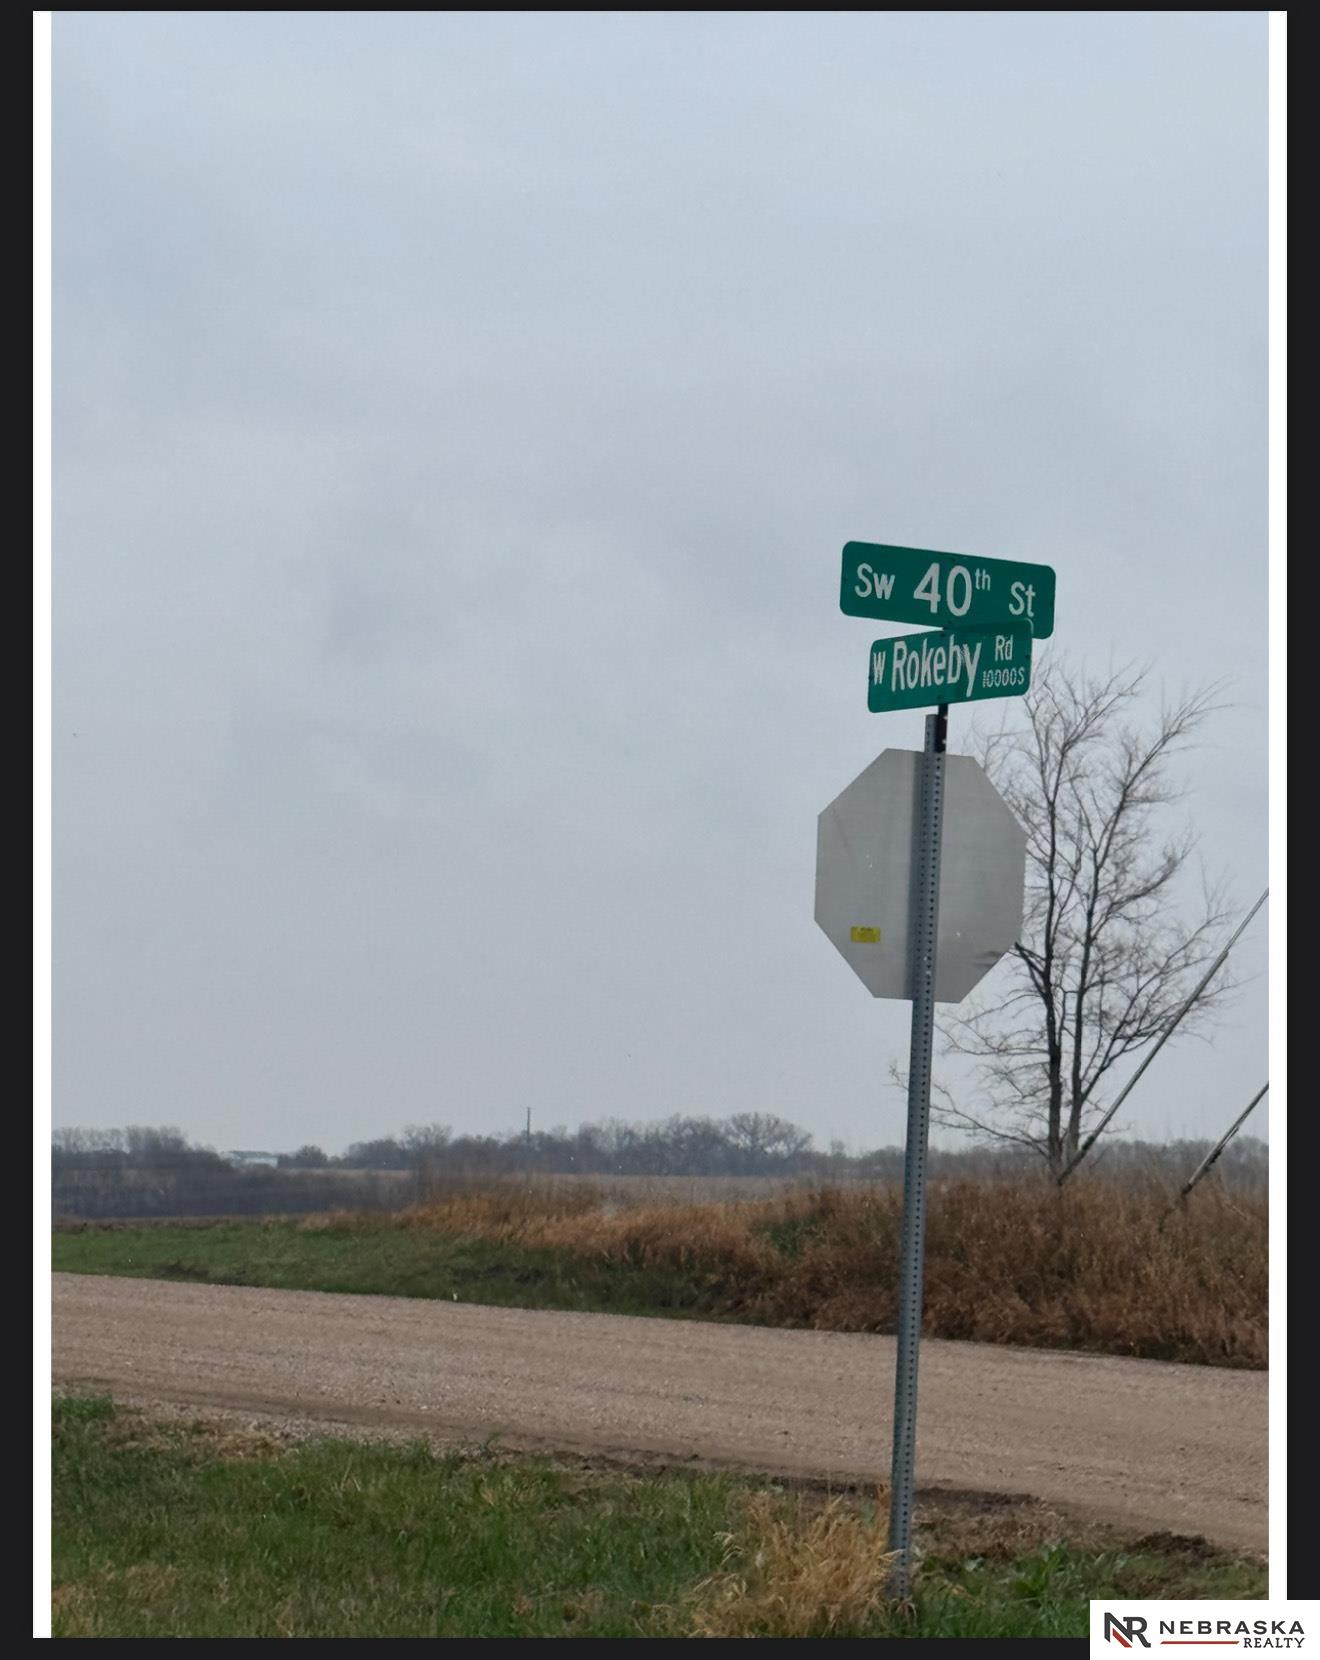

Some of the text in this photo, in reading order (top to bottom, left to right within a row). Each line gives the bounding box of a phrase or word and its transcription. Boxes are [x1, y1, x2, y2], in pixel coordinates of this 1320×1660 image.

[913, 562, 992, 617] 40th
[1008, 581, 1036, 618] St
[873, 634, 1014, 698] W Rokeby Rd
